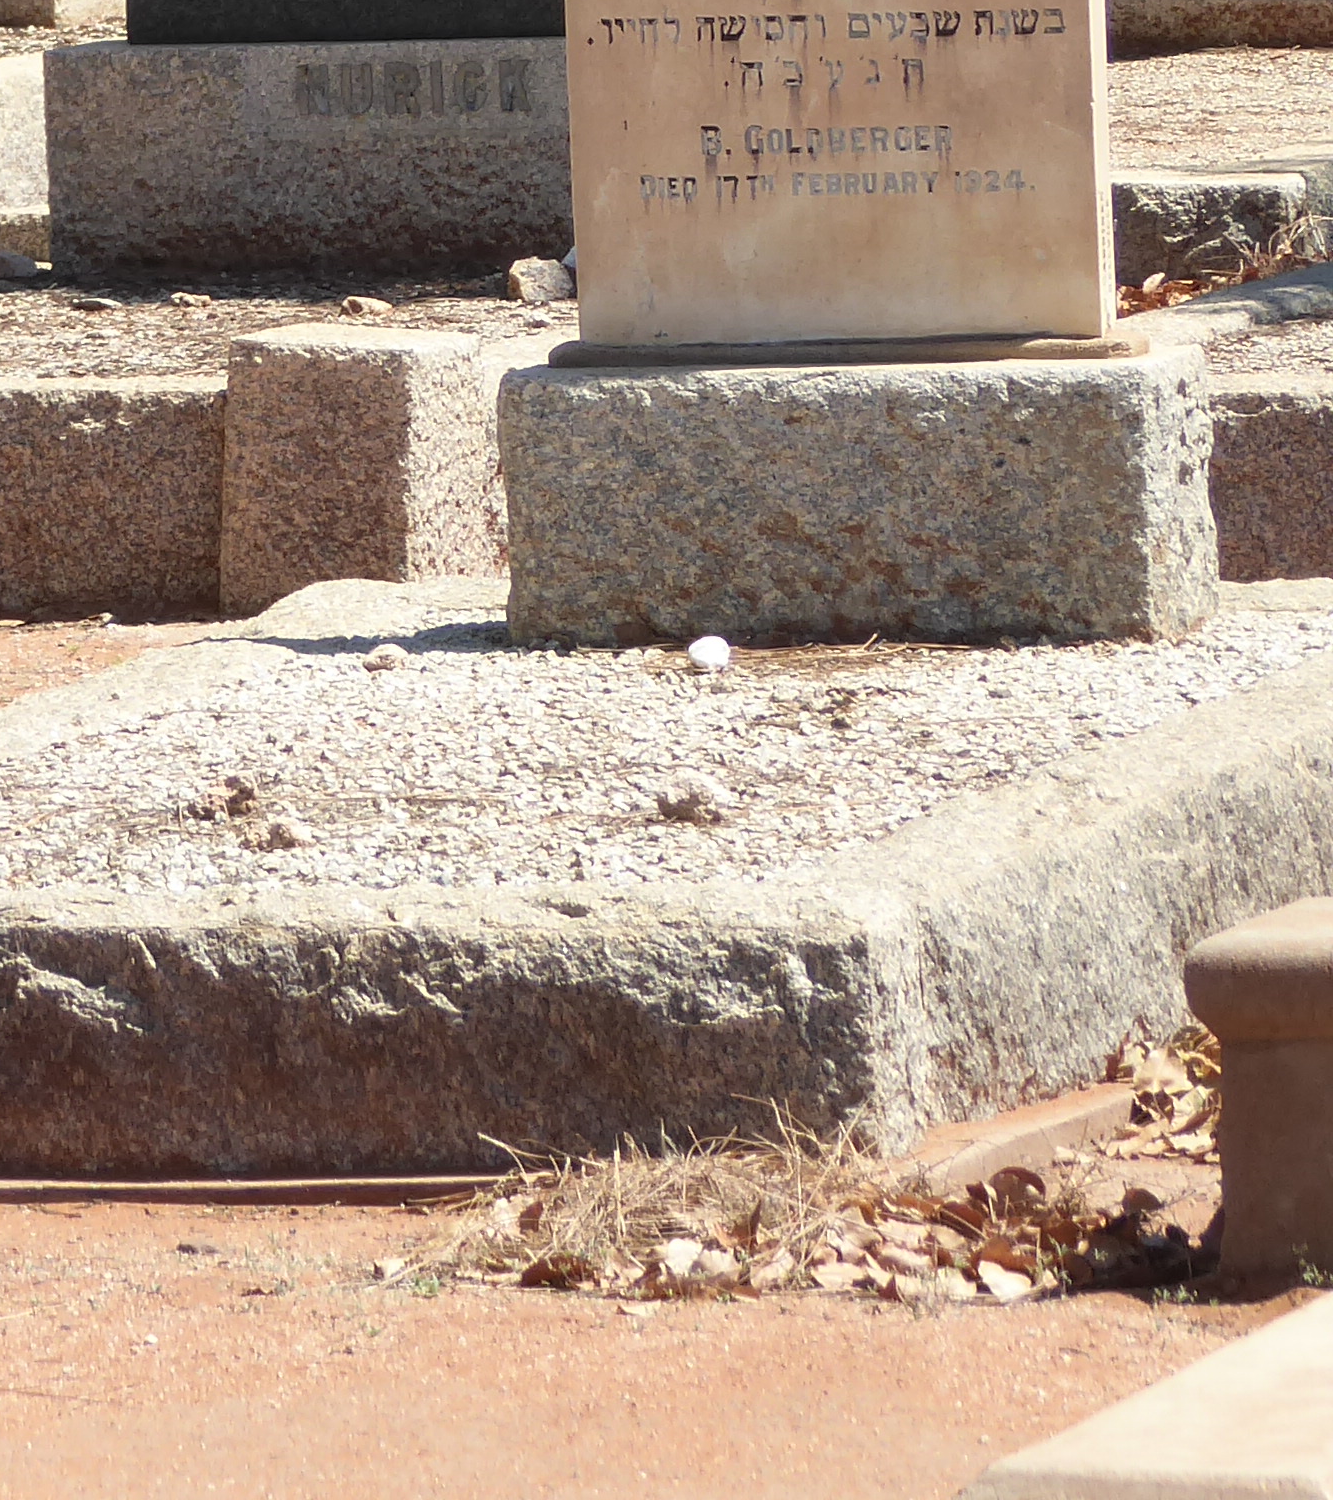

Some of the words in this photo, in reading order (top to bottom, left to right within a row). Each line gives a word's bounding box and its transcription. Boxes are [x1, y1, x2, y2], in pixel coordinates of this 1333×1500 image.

[295, 58, 531, 115] NURICK
[701, 125, 732, 156] B.
[744, 124, 953, 156] GOLDBERGER
[640, 174, 697, 200] DIED
[792, 171, 938, 197] FEBRUARY
